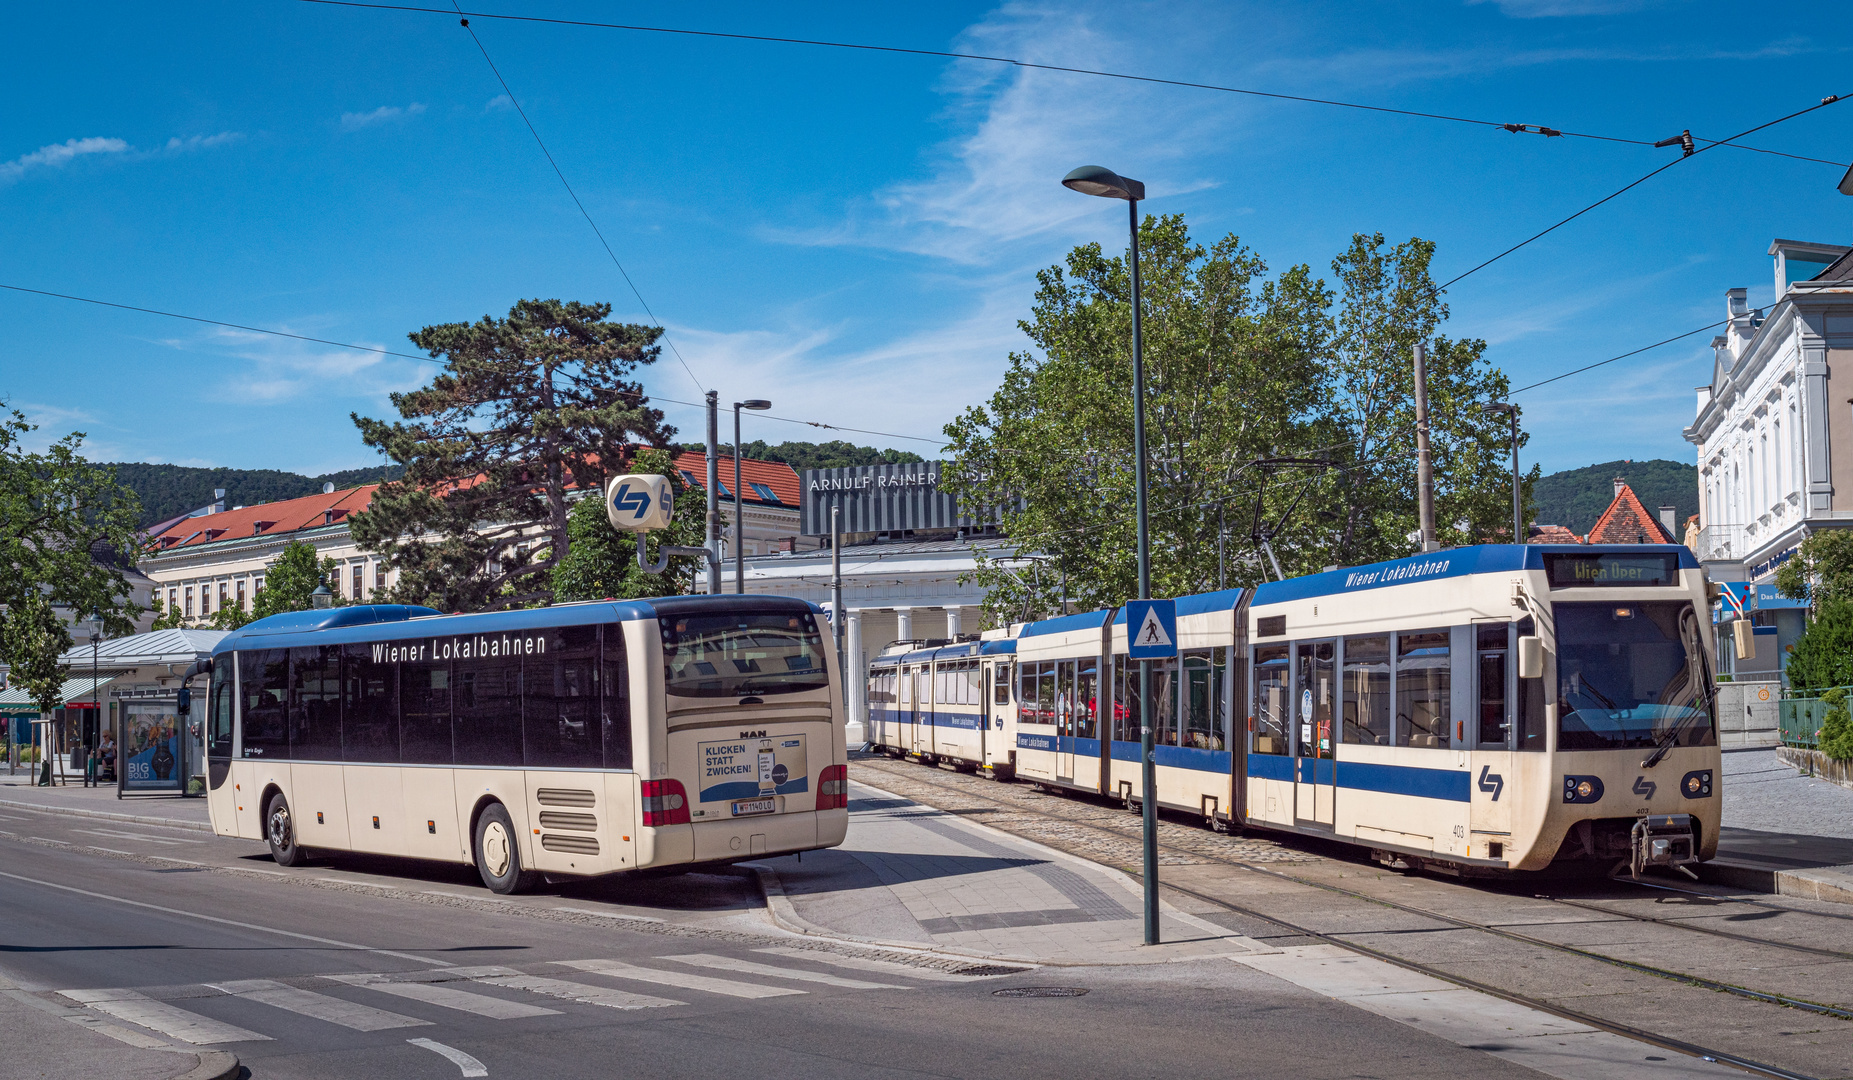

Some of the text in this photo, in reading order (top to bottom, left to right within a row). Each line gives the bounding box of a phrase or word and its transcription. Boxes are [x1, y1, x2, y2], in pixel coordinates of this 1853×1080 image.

[809, 476, 870, 492] ARNULF
[878, 472, 936, 488] RAINER
[1345, 559, 1450, 588] Wiener Lokalbahnen
[1575, 561, 1643, 579] Wien Oper
[372, 634, 545, 664] Wiener Lokalbahnen
[740, 730, 767, 739] MAN
[705, 744, 746, 756] KLICKEN
[128, 762, 150, 773] BIG
[706, 756, 734, 767] STATT
[706, 764, 752, 777] ZWICKEN!
[1636, 807, 1649, 815] 403
[1453, 824, 1465, 839] 403
